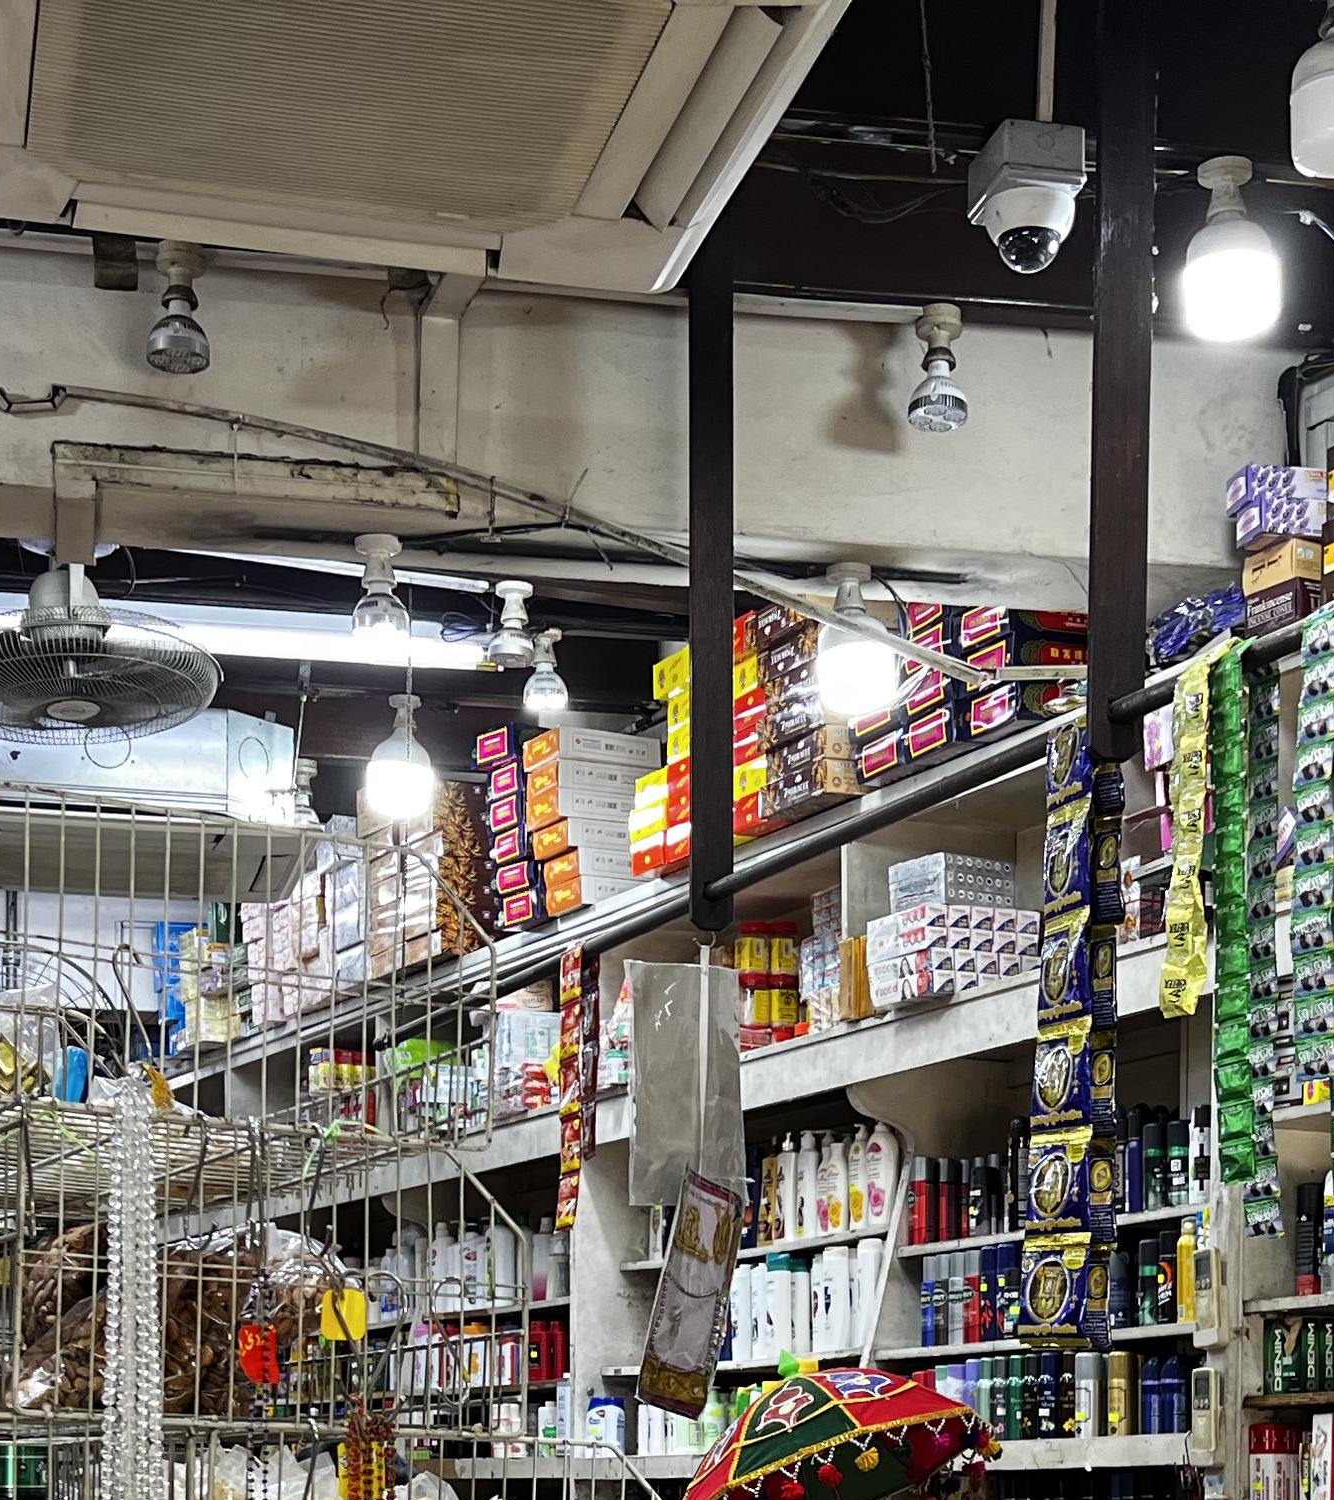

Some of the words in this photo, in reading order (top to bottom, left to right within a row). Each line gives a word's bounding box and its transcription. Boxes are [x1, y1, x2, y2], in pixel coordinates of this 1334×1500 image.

[1247, 591, 1293, 616] Frankincense
[1274, 1328, 1283, 1390] DENIM
[1307, 1322, 1316, 1378] DENIM
[1325, 1322, 1334, 1378] DENIM
